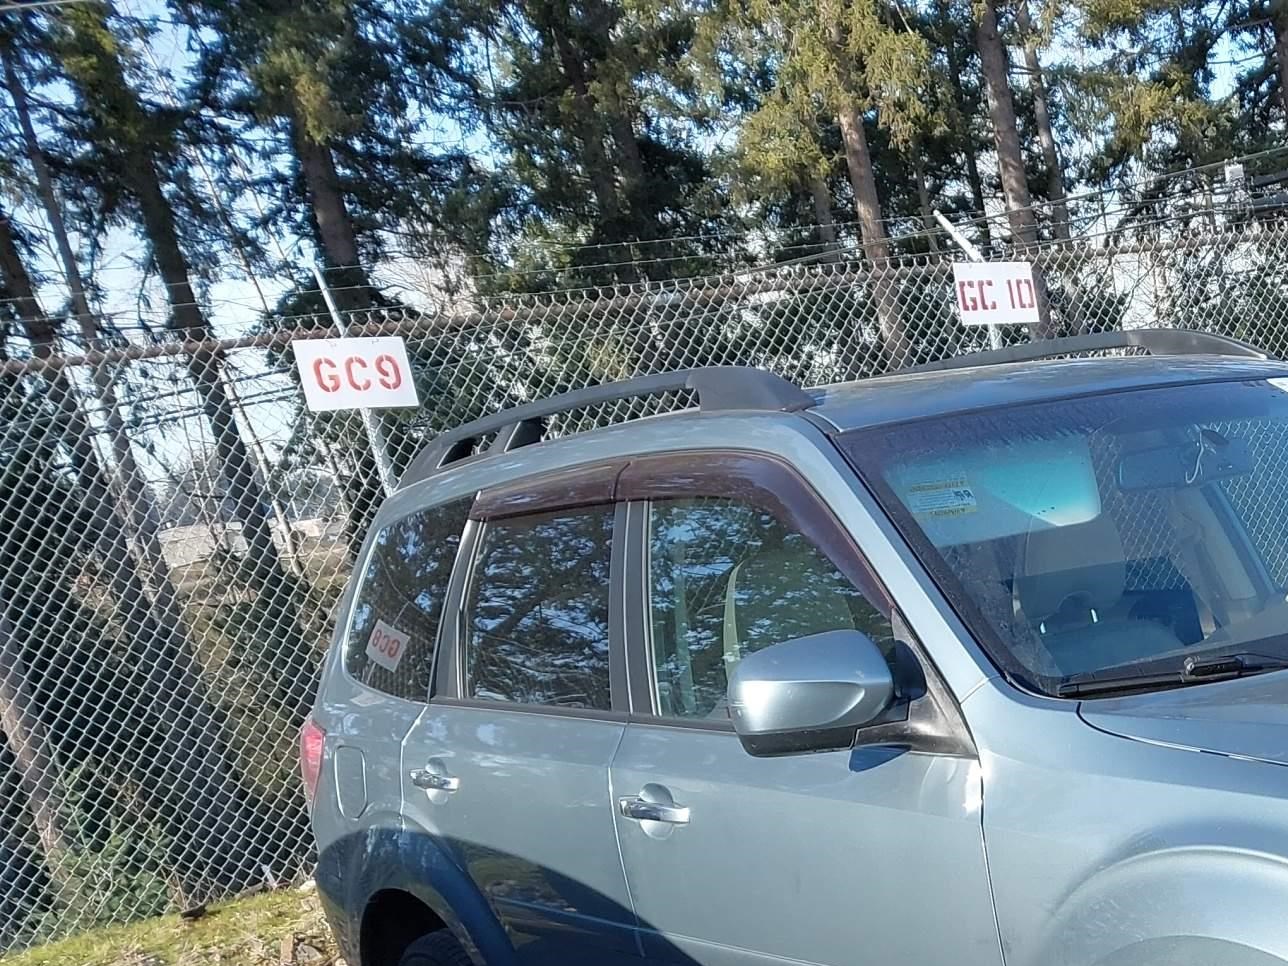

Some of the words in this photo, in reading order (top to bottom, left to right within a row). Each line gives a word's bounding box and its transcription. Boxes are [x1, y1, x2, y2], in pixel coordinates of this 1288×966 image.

[958, 280, 997, 311] GC
[1006, 279, 1035, 310] 10
[312, 354, 402, 393] GC9
